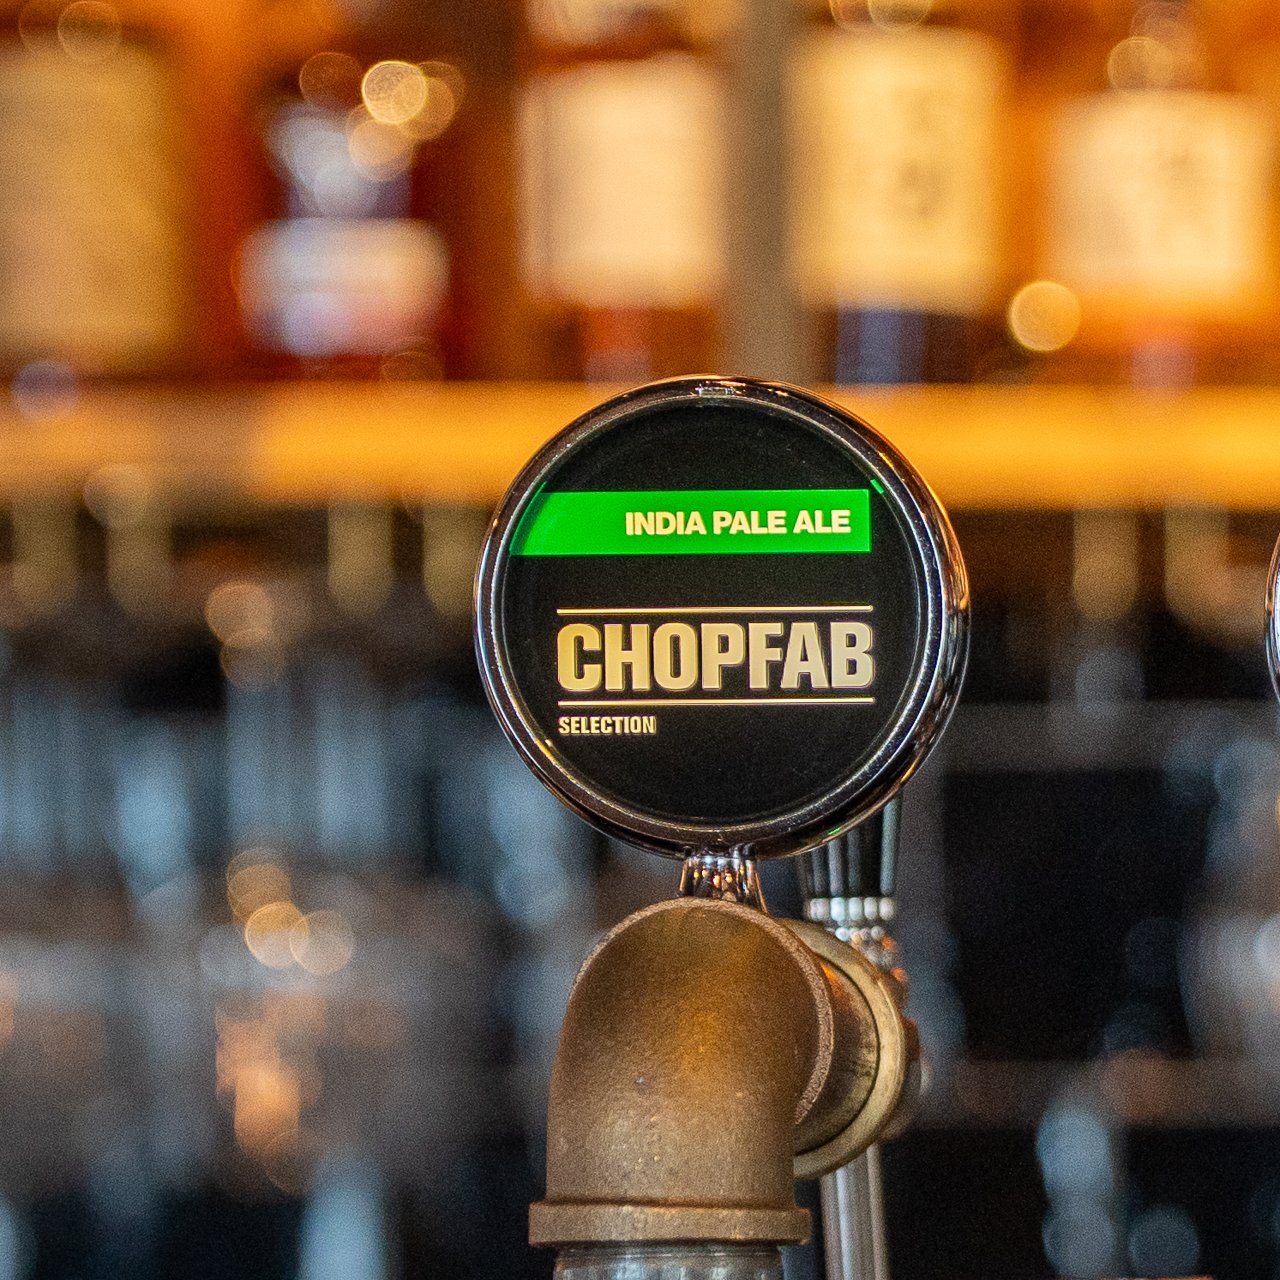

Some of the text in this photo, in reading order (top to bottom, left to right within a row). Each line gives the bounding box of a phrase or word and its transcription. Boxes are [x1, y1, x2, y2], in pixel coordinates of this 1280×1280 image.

[625, 509, 852, 536] INDIA PALE ALE
[556, 621, 876, 693] CHOPFAB
[558, 715, 656, 735] SELECTION
